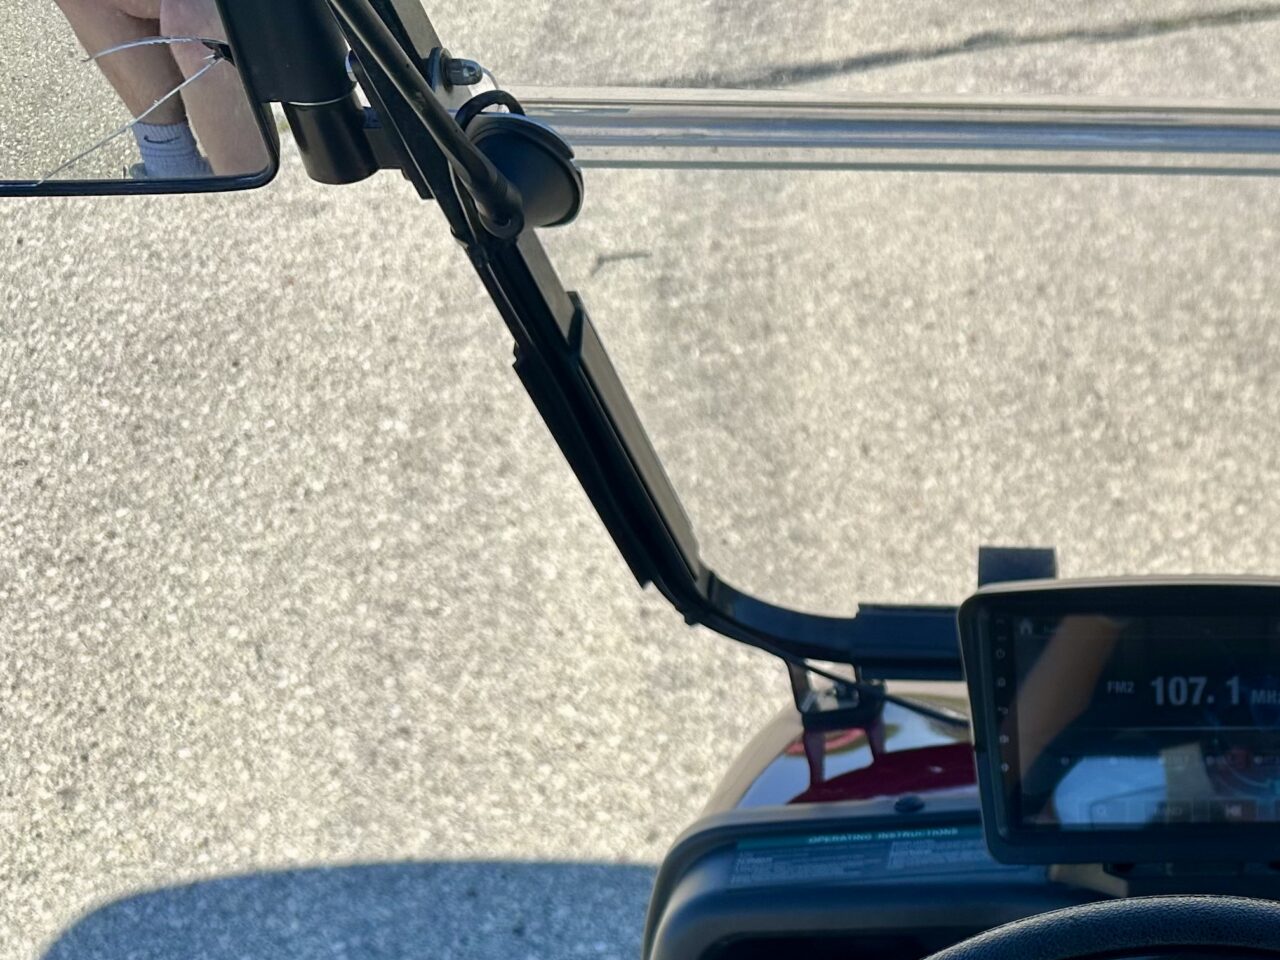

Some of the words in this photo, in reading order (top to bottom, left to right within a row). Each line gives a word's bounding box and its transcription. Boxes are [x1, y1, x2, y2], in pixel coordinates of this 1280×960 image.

[1107, 680, 1135, 694] FM2
[808, 832, 872, 844] OPERATING
[877, 827, 958, 841] INSTRUCTIONS
